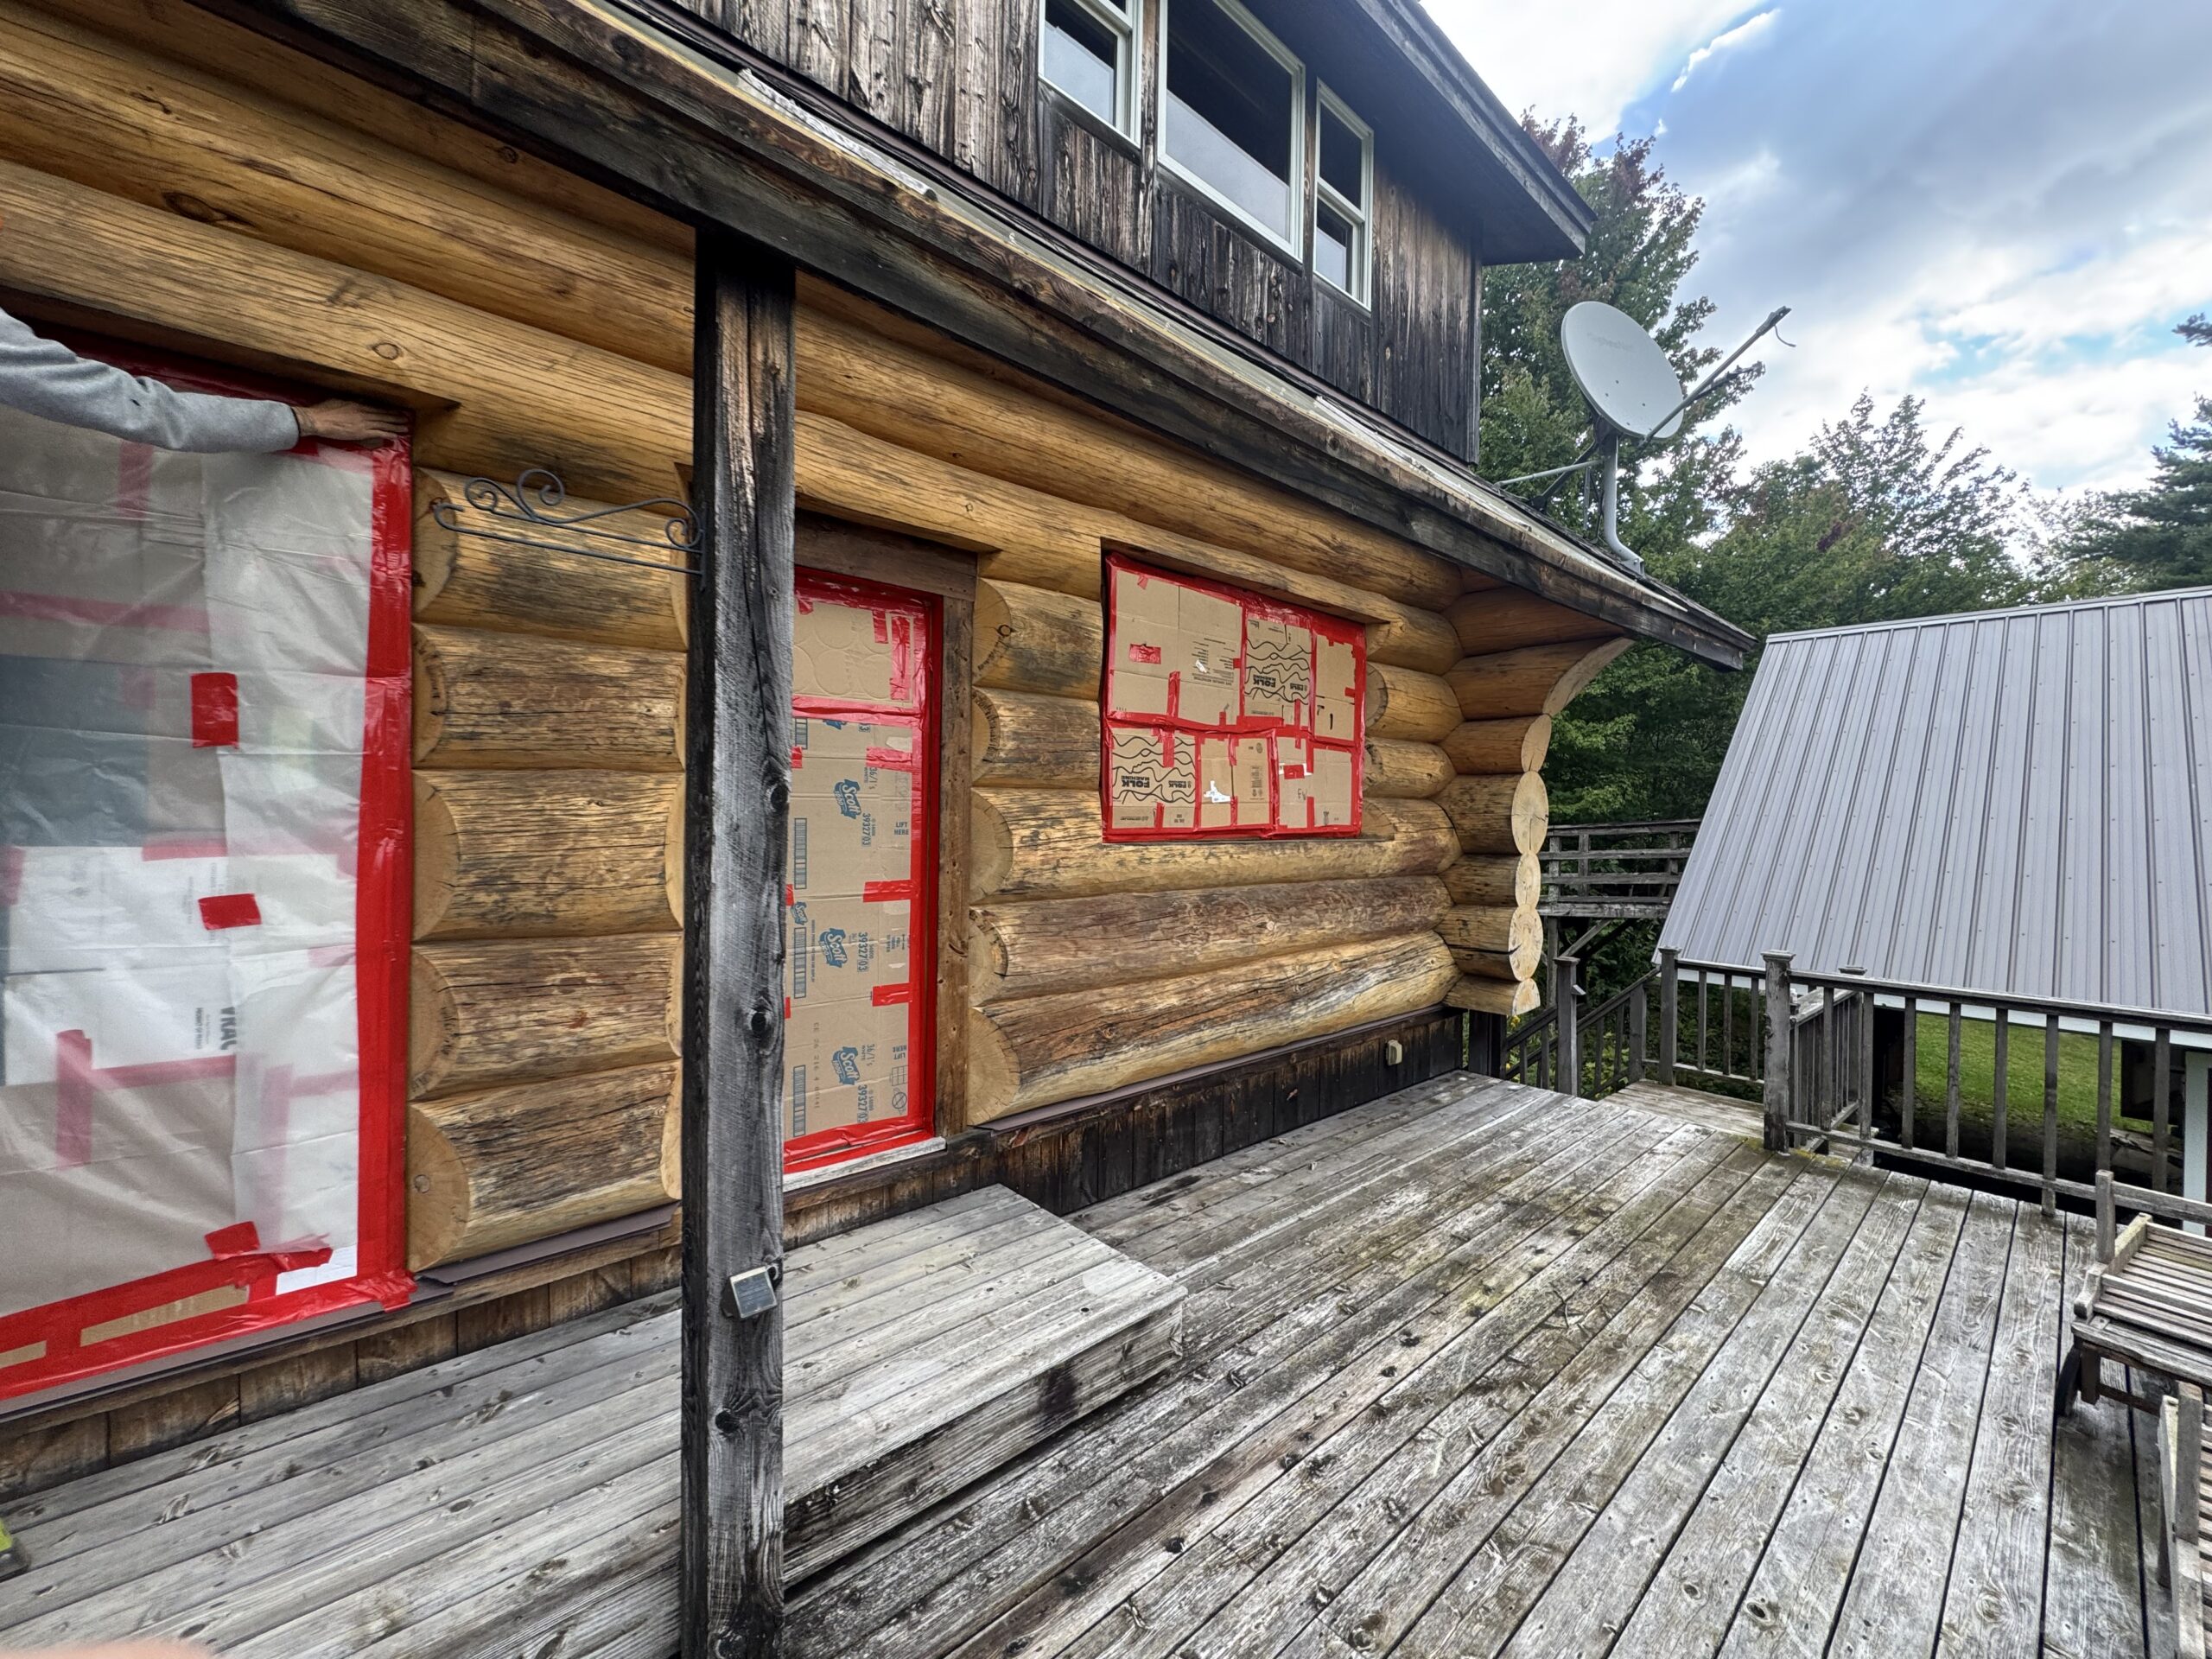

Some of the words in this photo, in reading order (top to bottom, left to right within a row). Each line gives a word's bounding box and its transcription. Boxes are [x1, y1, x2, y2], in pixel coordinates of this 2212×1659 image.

[1253, 678, 1275, 688] FOLK
[842, 785, 861, 814] Scott
[827, 934, 848, 962] Scott
[840, 1052, 859, 1079] Scott
